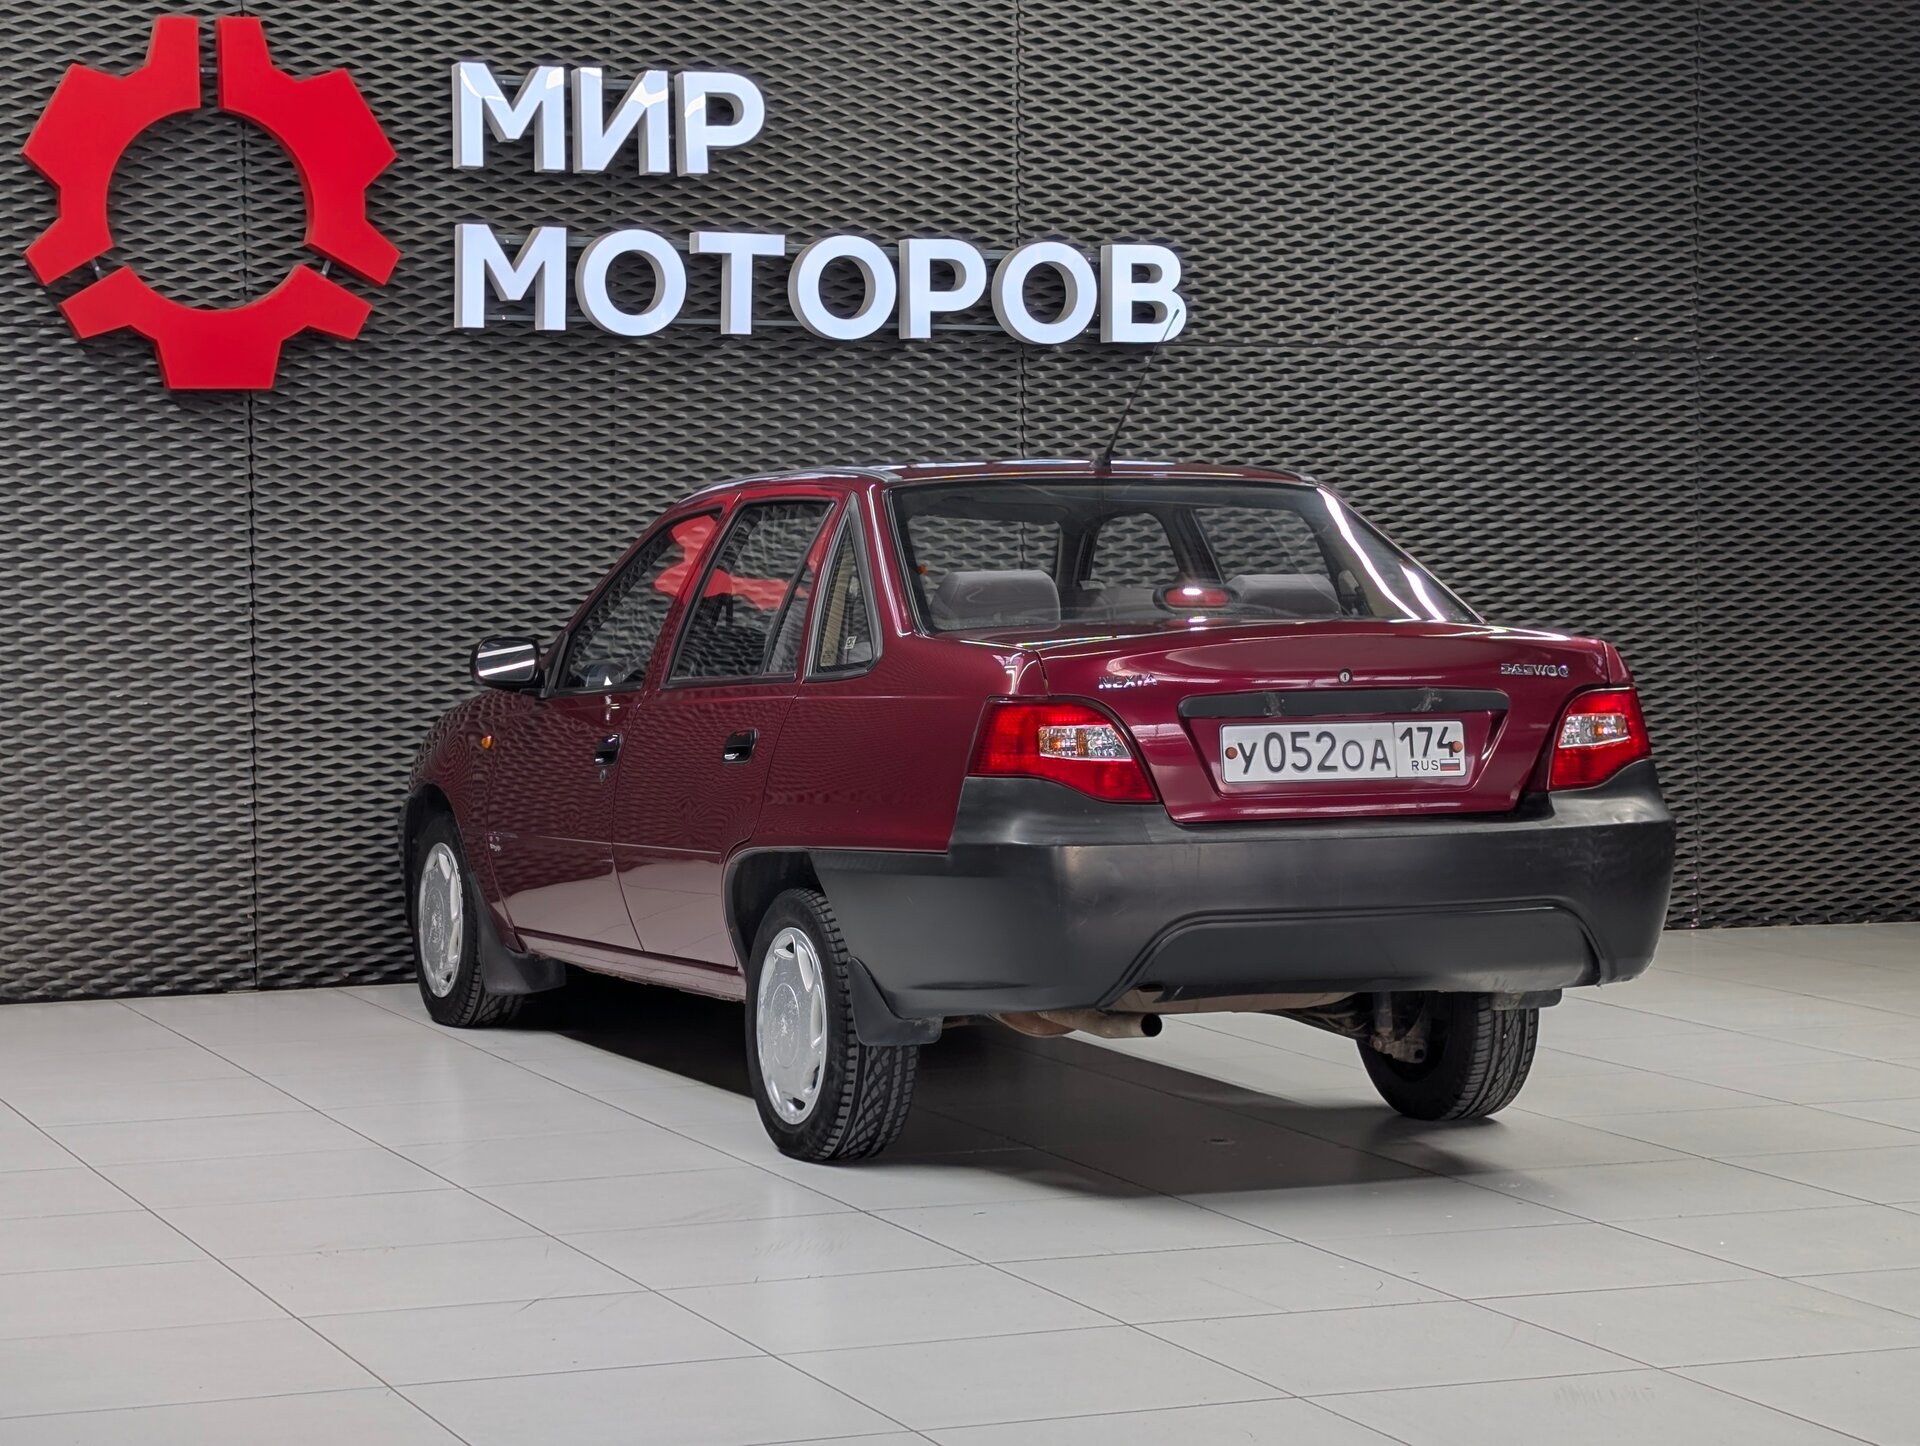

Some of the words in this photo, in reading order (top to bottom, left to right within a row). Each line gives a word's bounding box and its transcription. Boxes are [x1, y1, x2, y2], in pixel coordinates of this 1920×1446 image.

[452, 61, 765, 175] МИР
[453, 223, 1187, 344] МОТОРОВ
[1098, 674, 1158, 689] NEXIA
[1500, 663, 1569, 677] DAEWOO
[1399, 726, 1455, 759] 174
[1411, 759, 1439, 771] RUS
